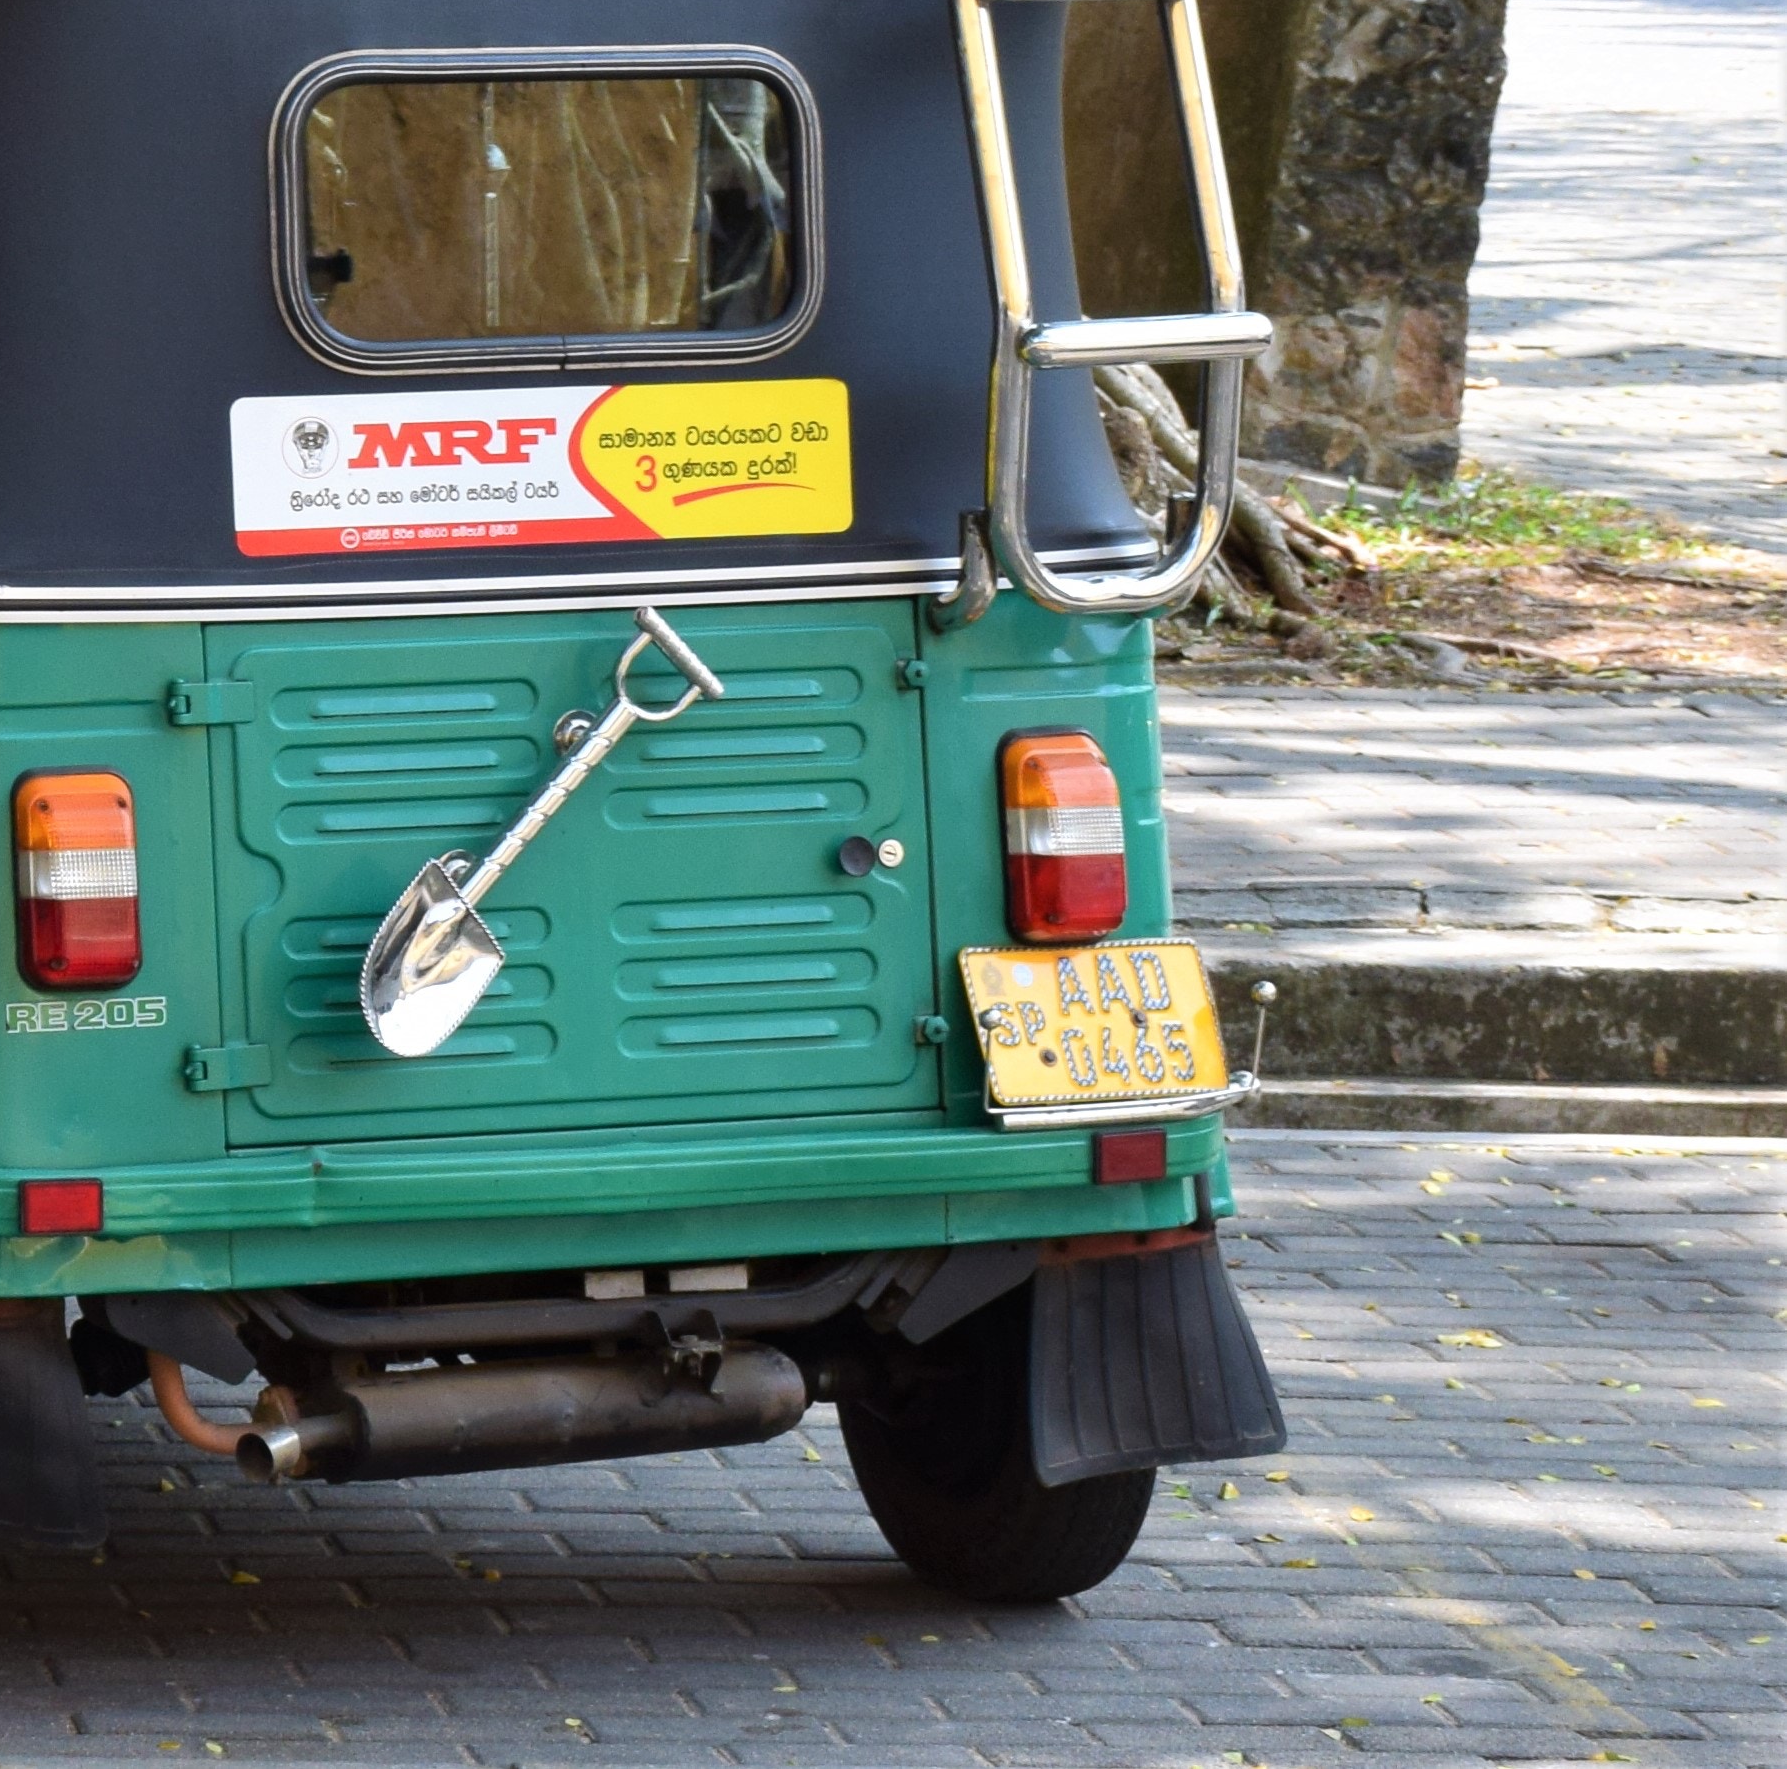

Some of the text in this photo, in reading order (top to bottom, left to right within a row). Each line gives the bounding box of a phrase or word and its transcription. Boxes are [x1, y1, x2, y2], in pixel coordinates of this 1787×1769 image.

[347, 417, 557, 470] MRF
[599, 421, 828, 449] සාමාන්‍ය ටයරයකට වඩා
[377, 490, 403, 504] සහ
[466, 480, 518, 503] සයිකල්
[524, 480, 559, 499] ටයර්
[635, 455, 658, 492] 3
[663, 458, 738, 483] ගුණයක
[1057, 950, 1172, 1016] AAD
[6, 996, 166, 1034] RE 205
[989, 1001, 1046, 1046] SP
[1060, 1021, 1196, 1088] 0465
